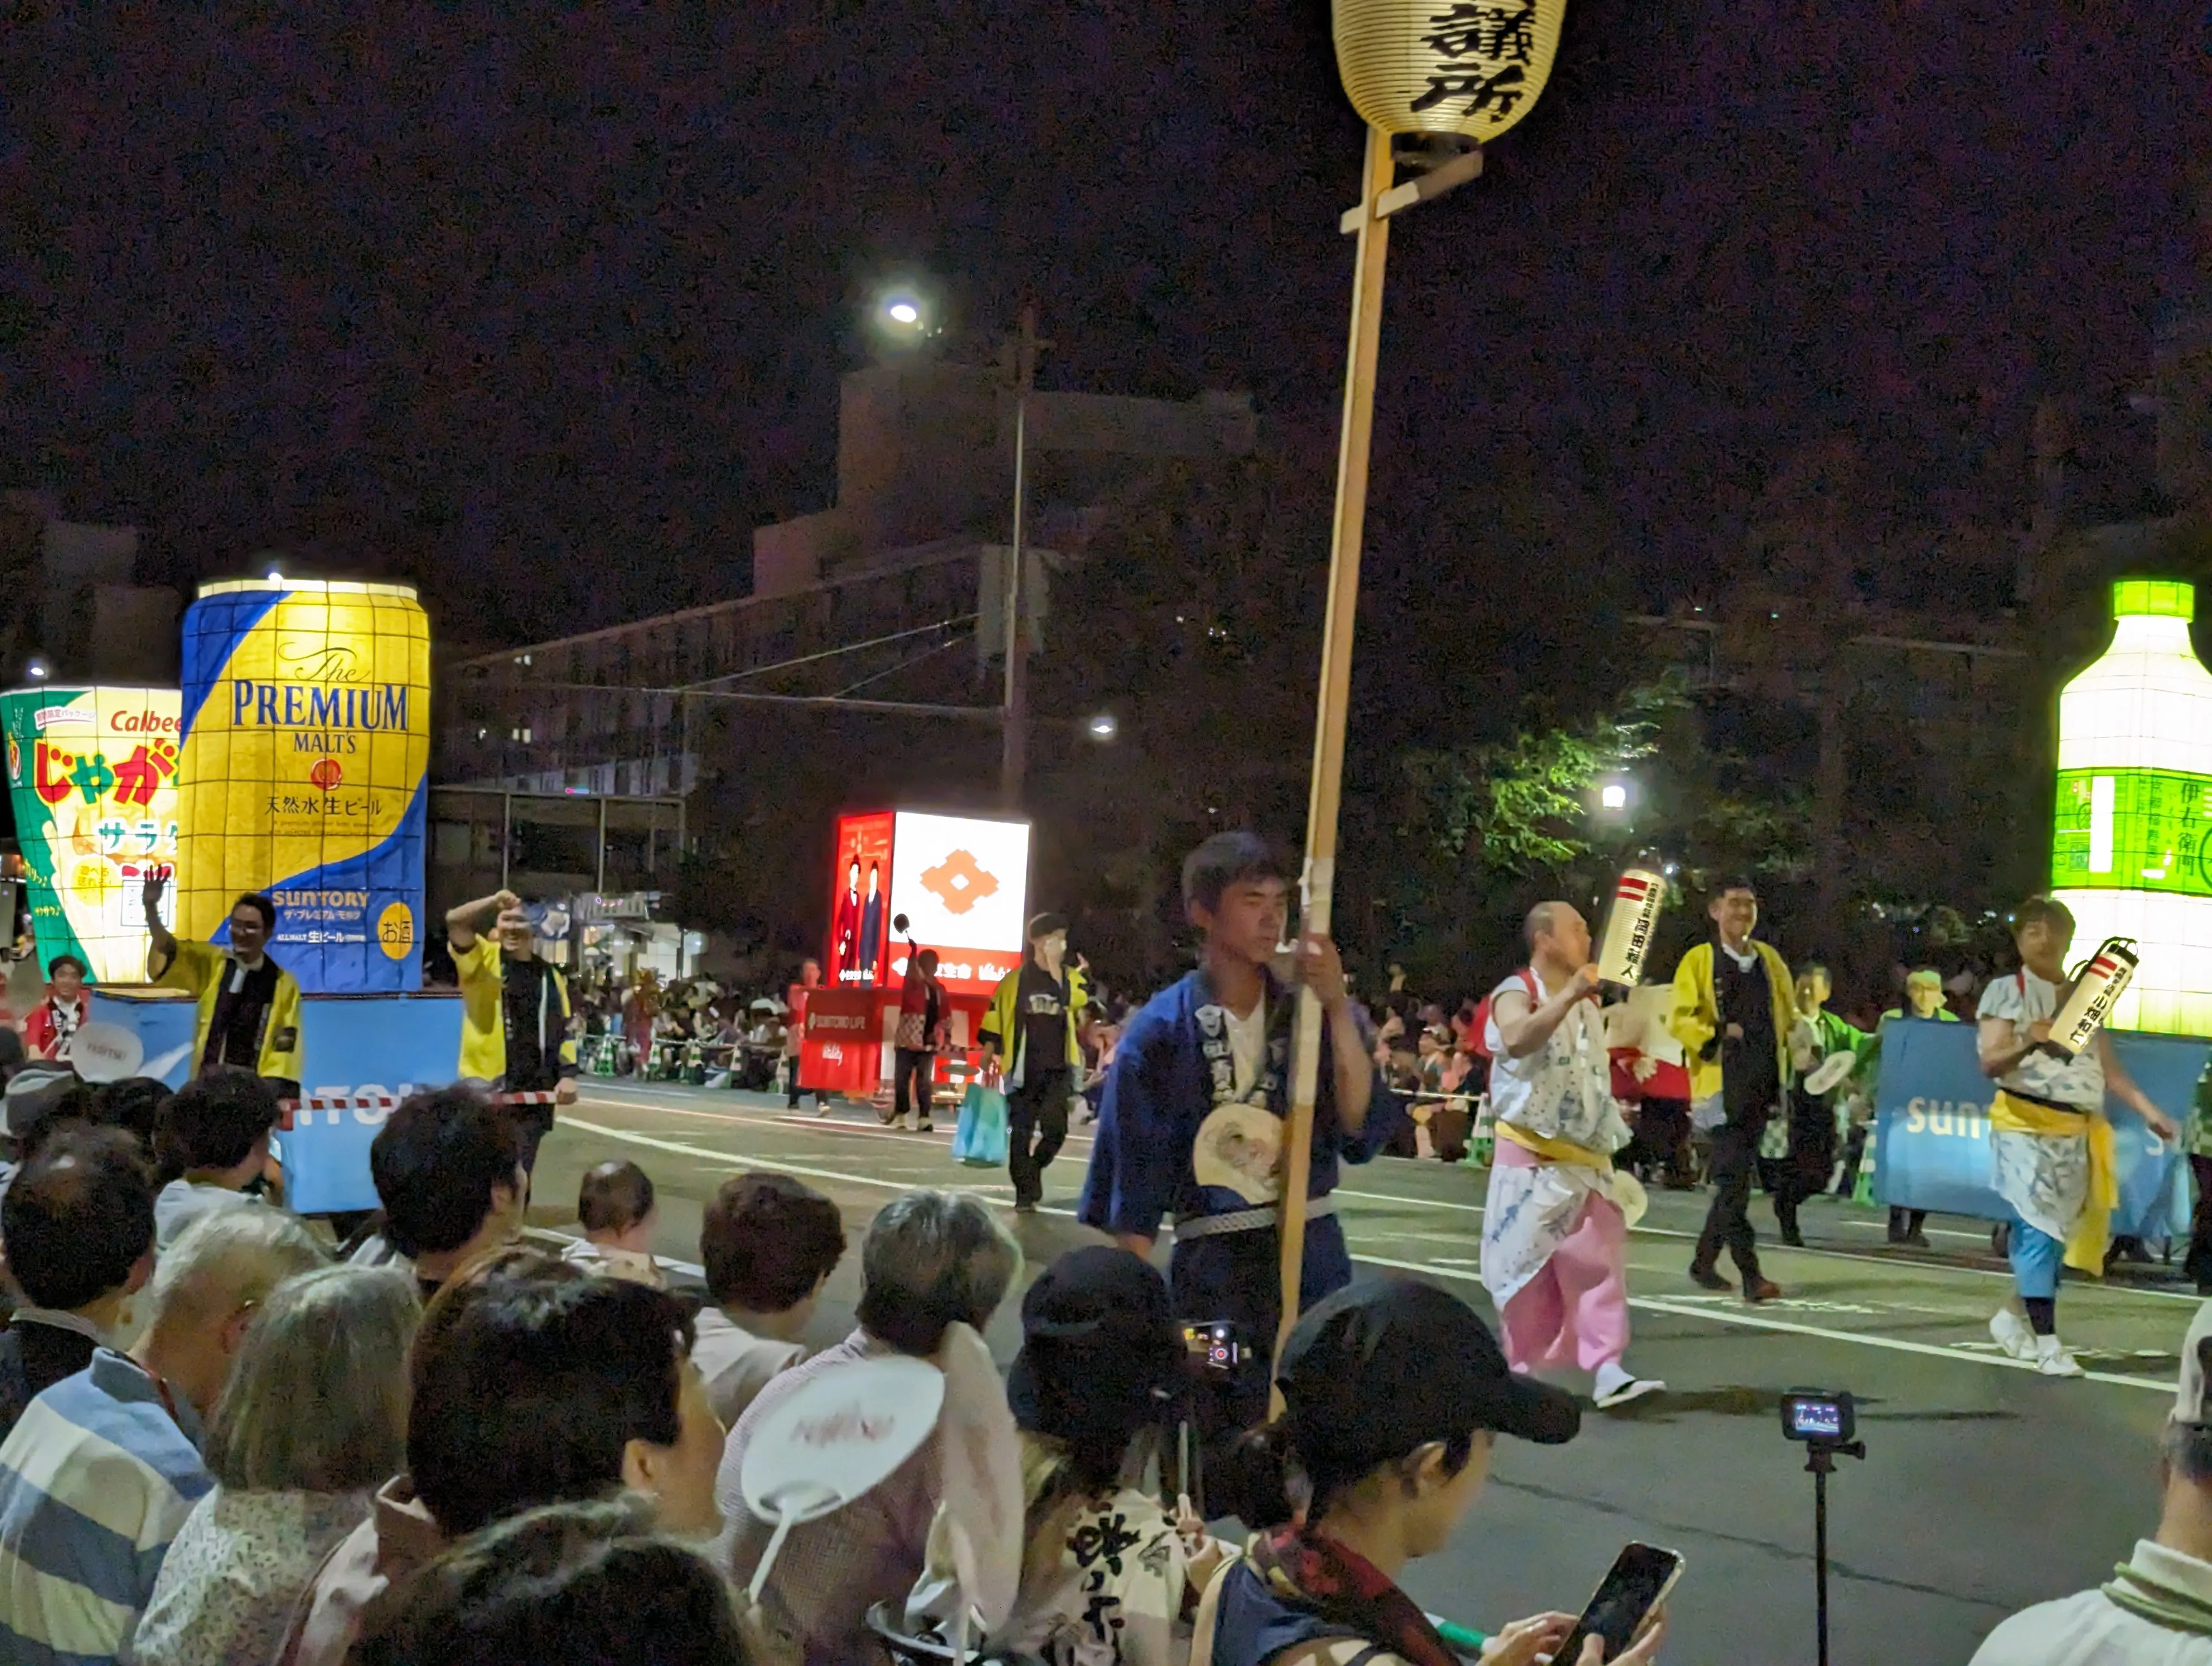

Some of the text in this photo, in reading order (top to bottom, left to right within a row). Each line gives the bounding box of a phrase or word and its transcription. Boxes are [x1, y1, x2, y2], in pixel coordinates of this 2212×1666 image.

[278, 642, 371, 682] The
[233, 679, 408, 732] PREMIUM
[293, 732, 356, 754] MALT'S
[37, 738, 180, 806] じゃが
